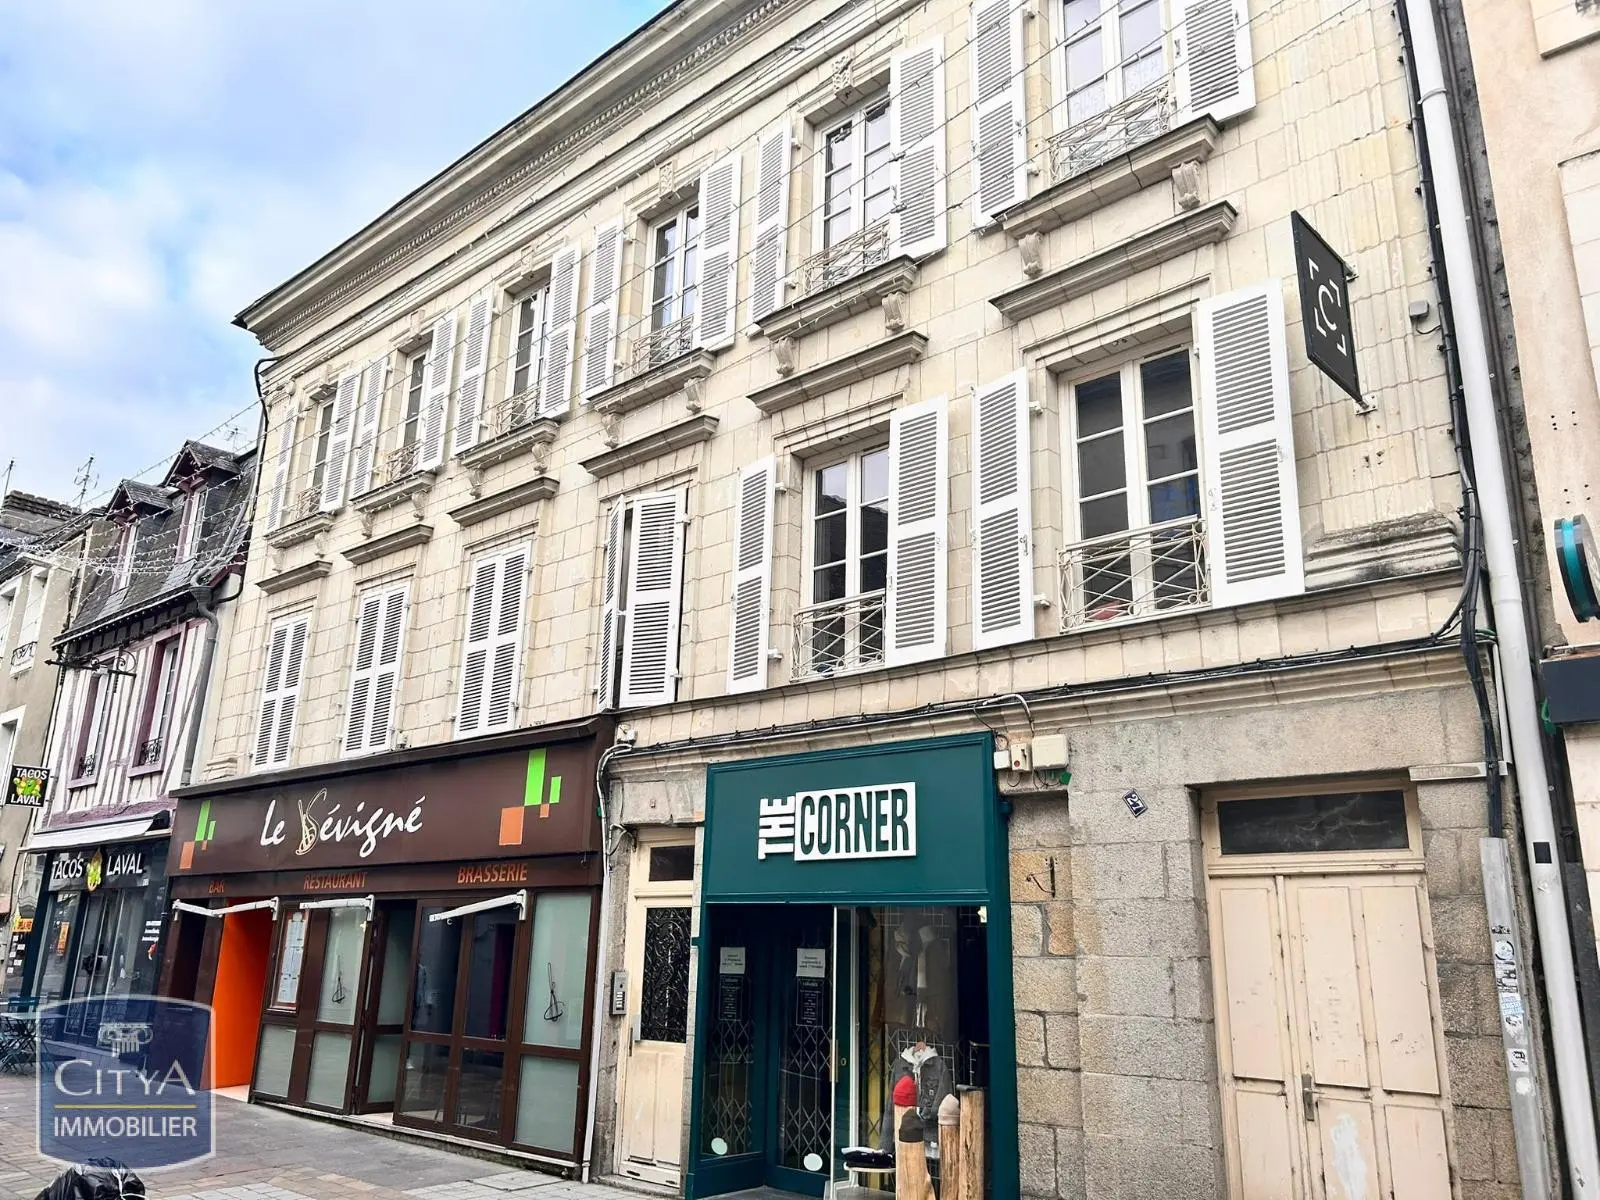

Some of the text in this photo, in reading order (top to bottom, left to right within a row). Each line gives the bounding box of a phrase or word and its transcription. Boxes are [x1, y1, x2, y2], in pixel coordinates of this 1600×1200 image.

[15, 768, 48, 780] TACOS
[10, 793, 42, 805] LAVAL
[1126, 793, 1144, 811] 27
[260, 788, 426, 858] Le Sévigné
[757, 795, 796, 860] THE
[800, 788, 910, 855] CORNER
[106, 852, 144, 876] LAVAL
[456, 862, 528, 884] BRASSERIE
[208, 880, 225, 894] BAR
[303, 871, 368, 890] RESTAURANT
